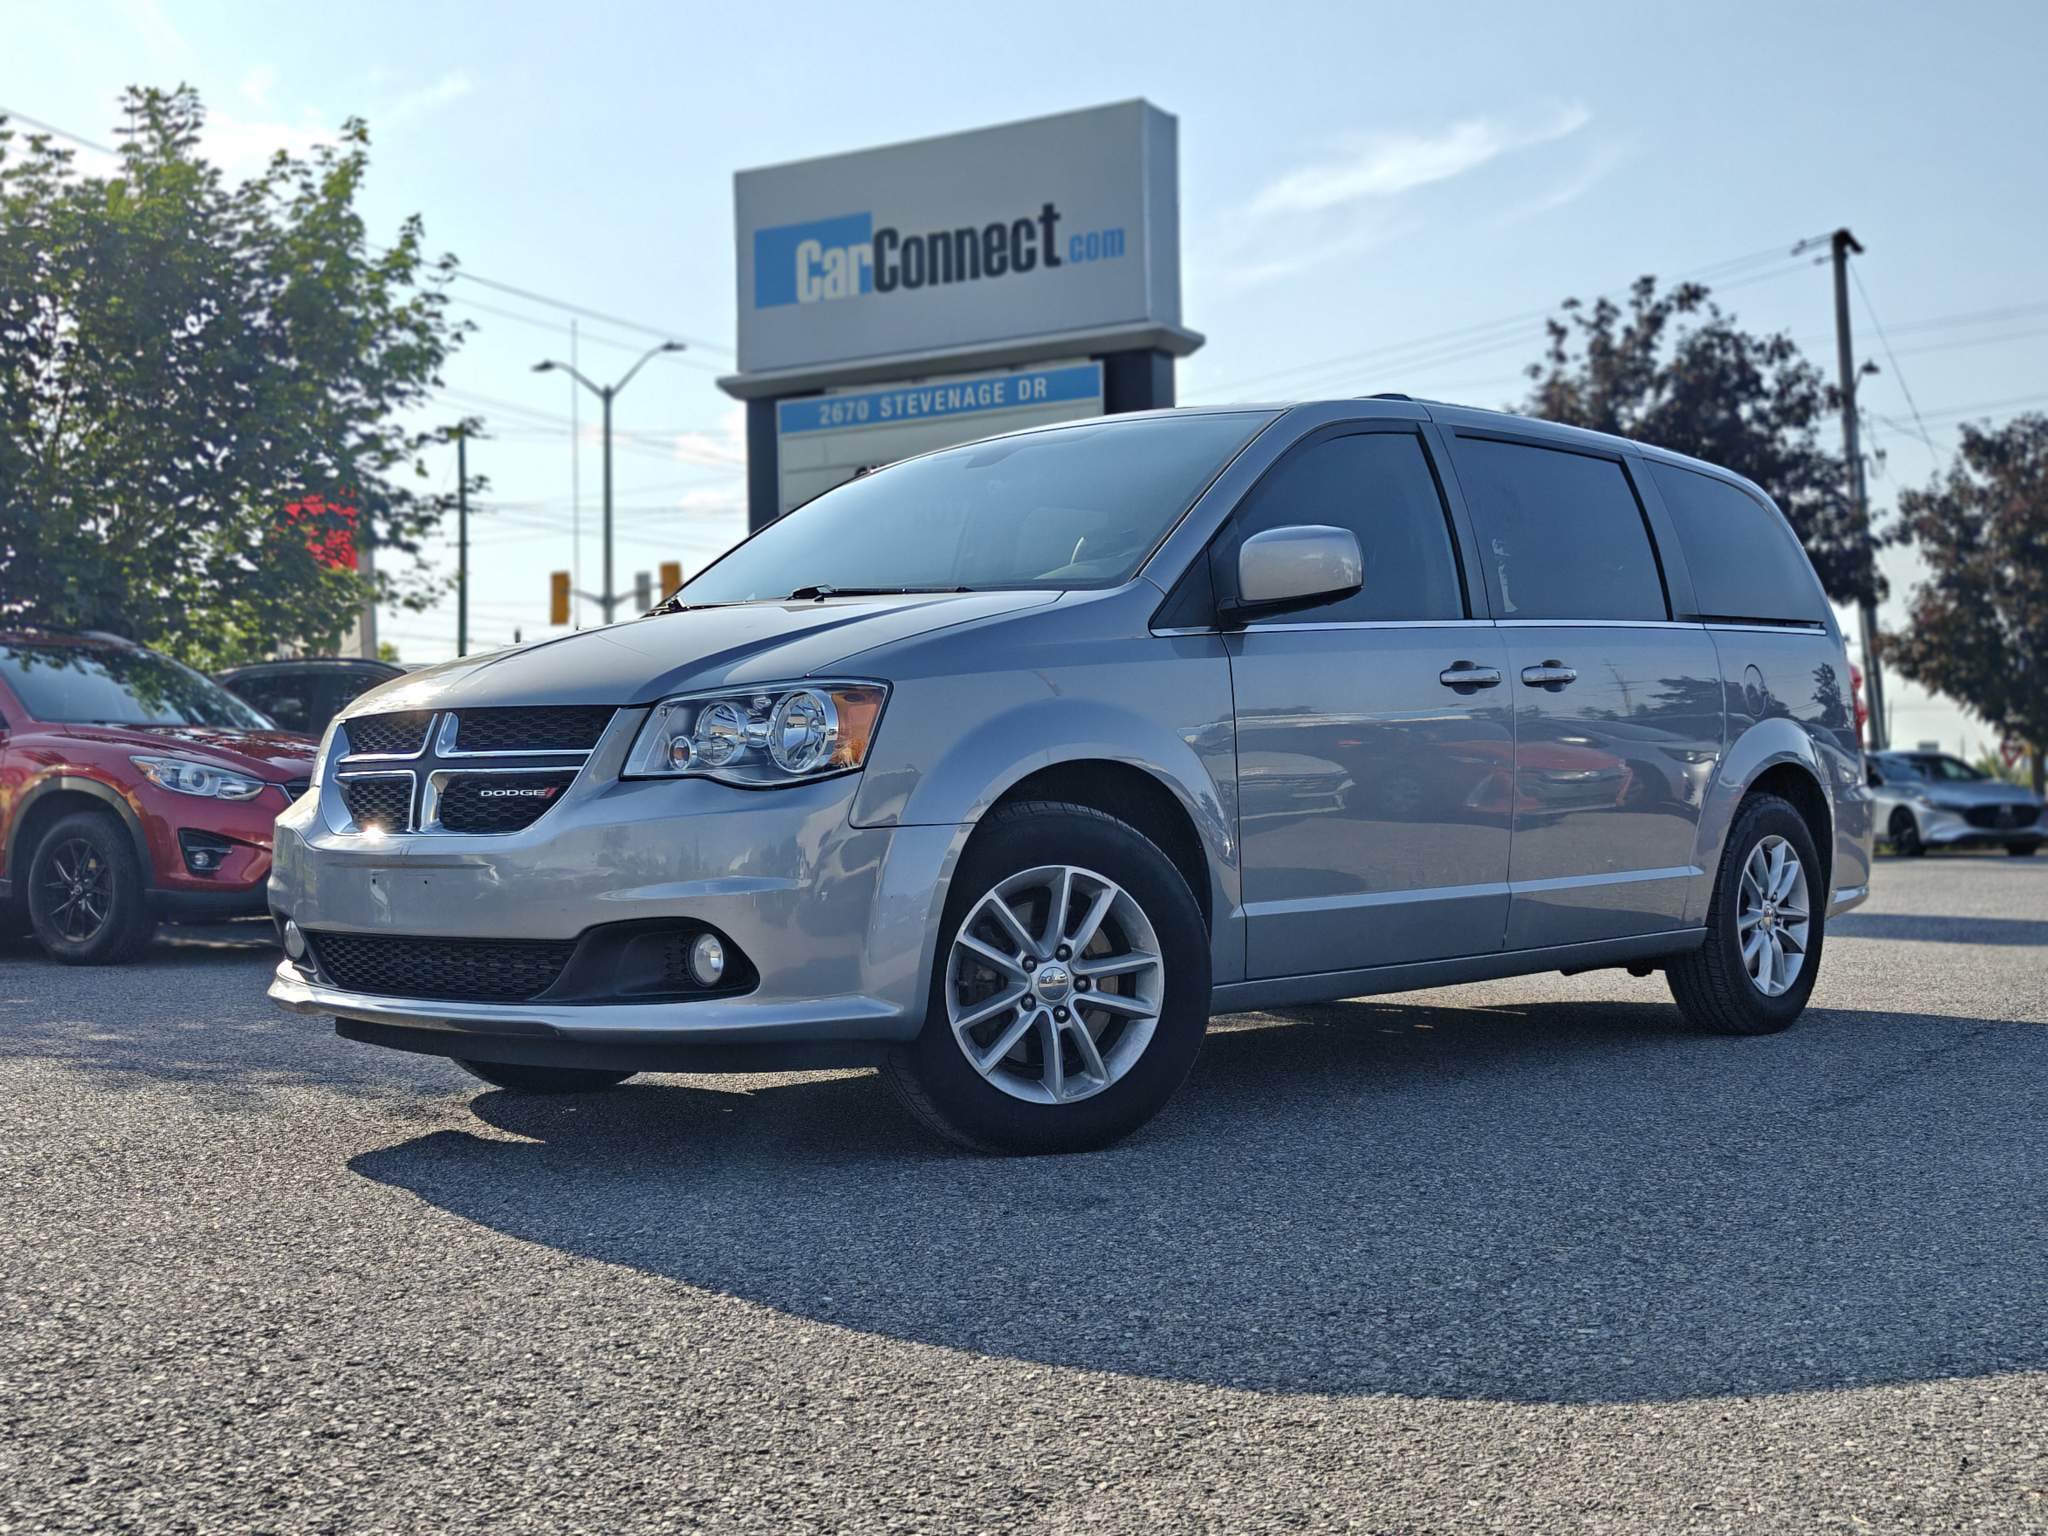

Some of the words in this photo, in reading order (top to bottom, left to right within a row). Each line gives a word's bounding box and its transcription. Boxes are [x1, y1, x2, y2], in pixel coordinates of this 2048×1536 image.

[819, 402, 870, 425] 2670
[880, 382, 1005, 418] STEVENAGE
[1018, 377, 1048, 400] DR
[480, 789, 546, 797] DODGE
